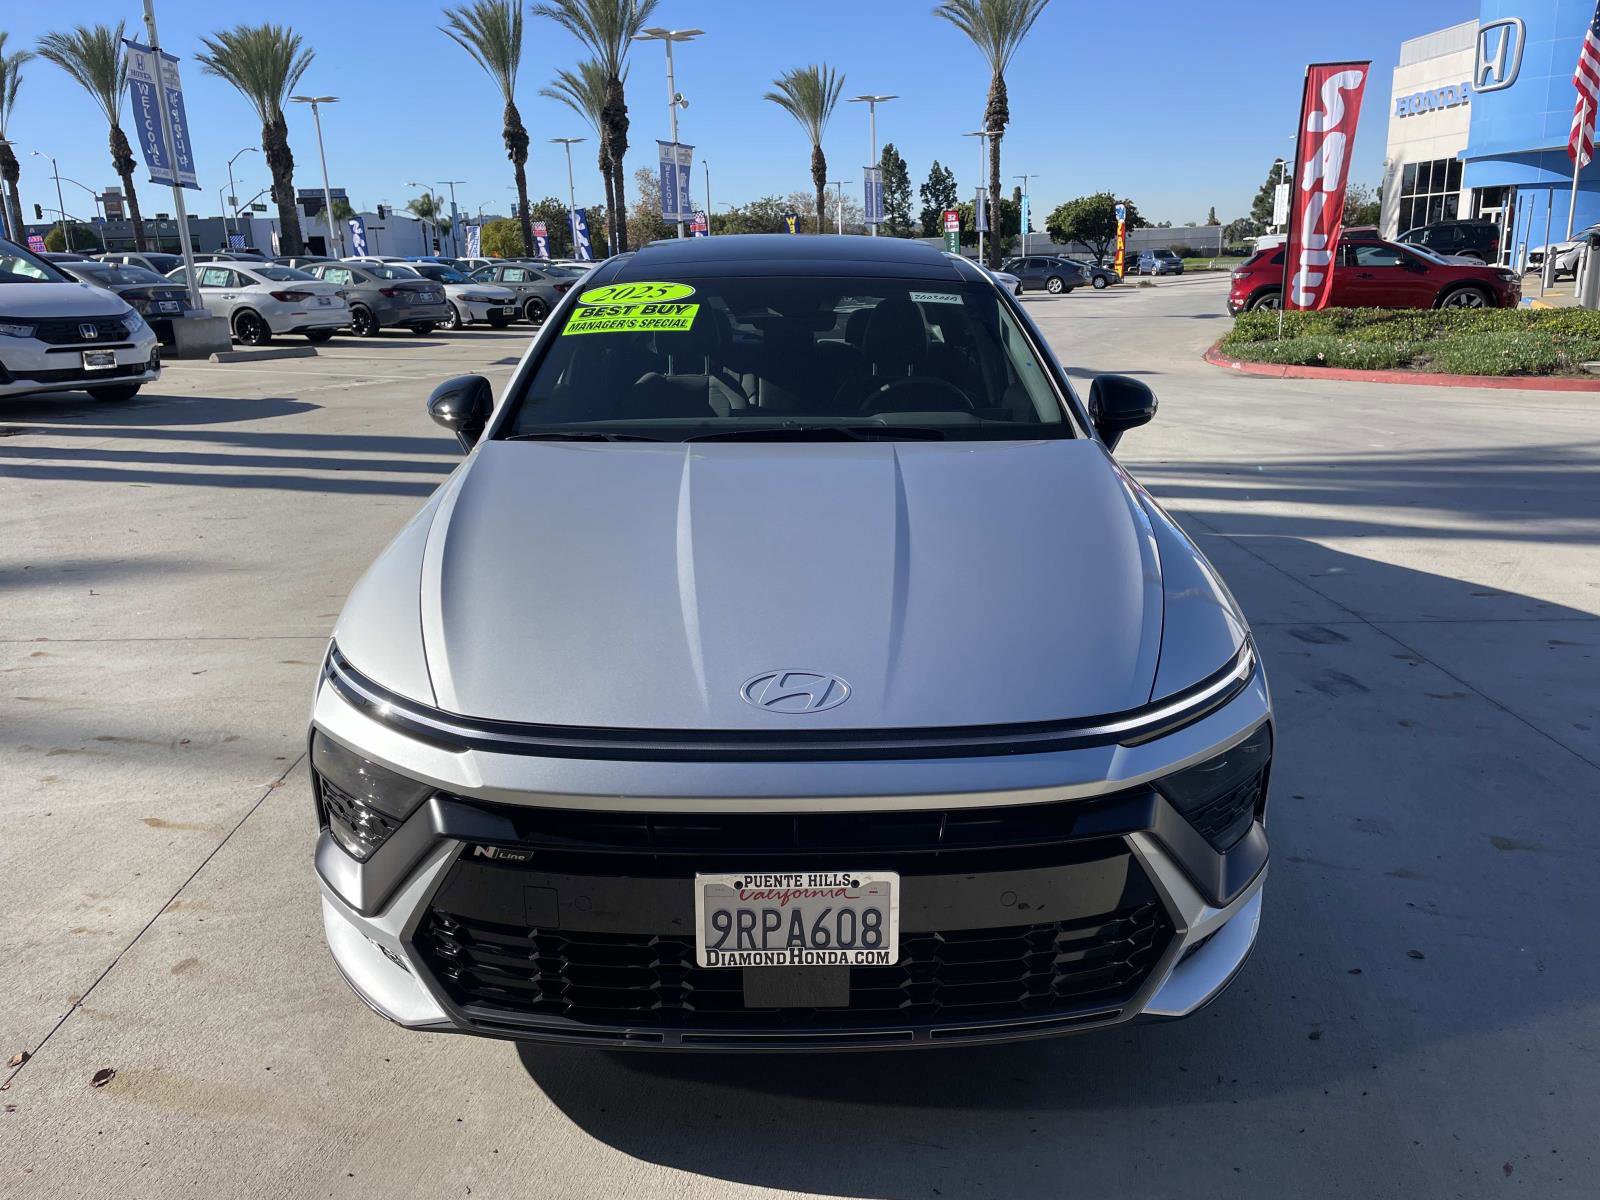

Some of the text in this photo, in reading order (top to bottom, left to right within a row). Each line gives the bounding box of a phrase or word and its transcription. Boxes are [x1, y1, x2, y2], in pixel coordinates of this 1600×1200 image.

[1395, 82, 1472, 117] HONDA
[138, 82, 160, 166] WELCOME
[664, 164, 673, 213] WELCOME
[1291, 70, 1364, 306] SALE
[591, 285, 675, 302] 2025
[579, 304, 692, 318] BEST BUY
[567, 318, 688, 332] MANAGER'S SPECIAL
[473, 845, 497, 859] N
[744, 873, 851, 889] PUENTE HILLS
[739, 888, 860, 907] California
[711, 907, 883, 950] 9RPA608
